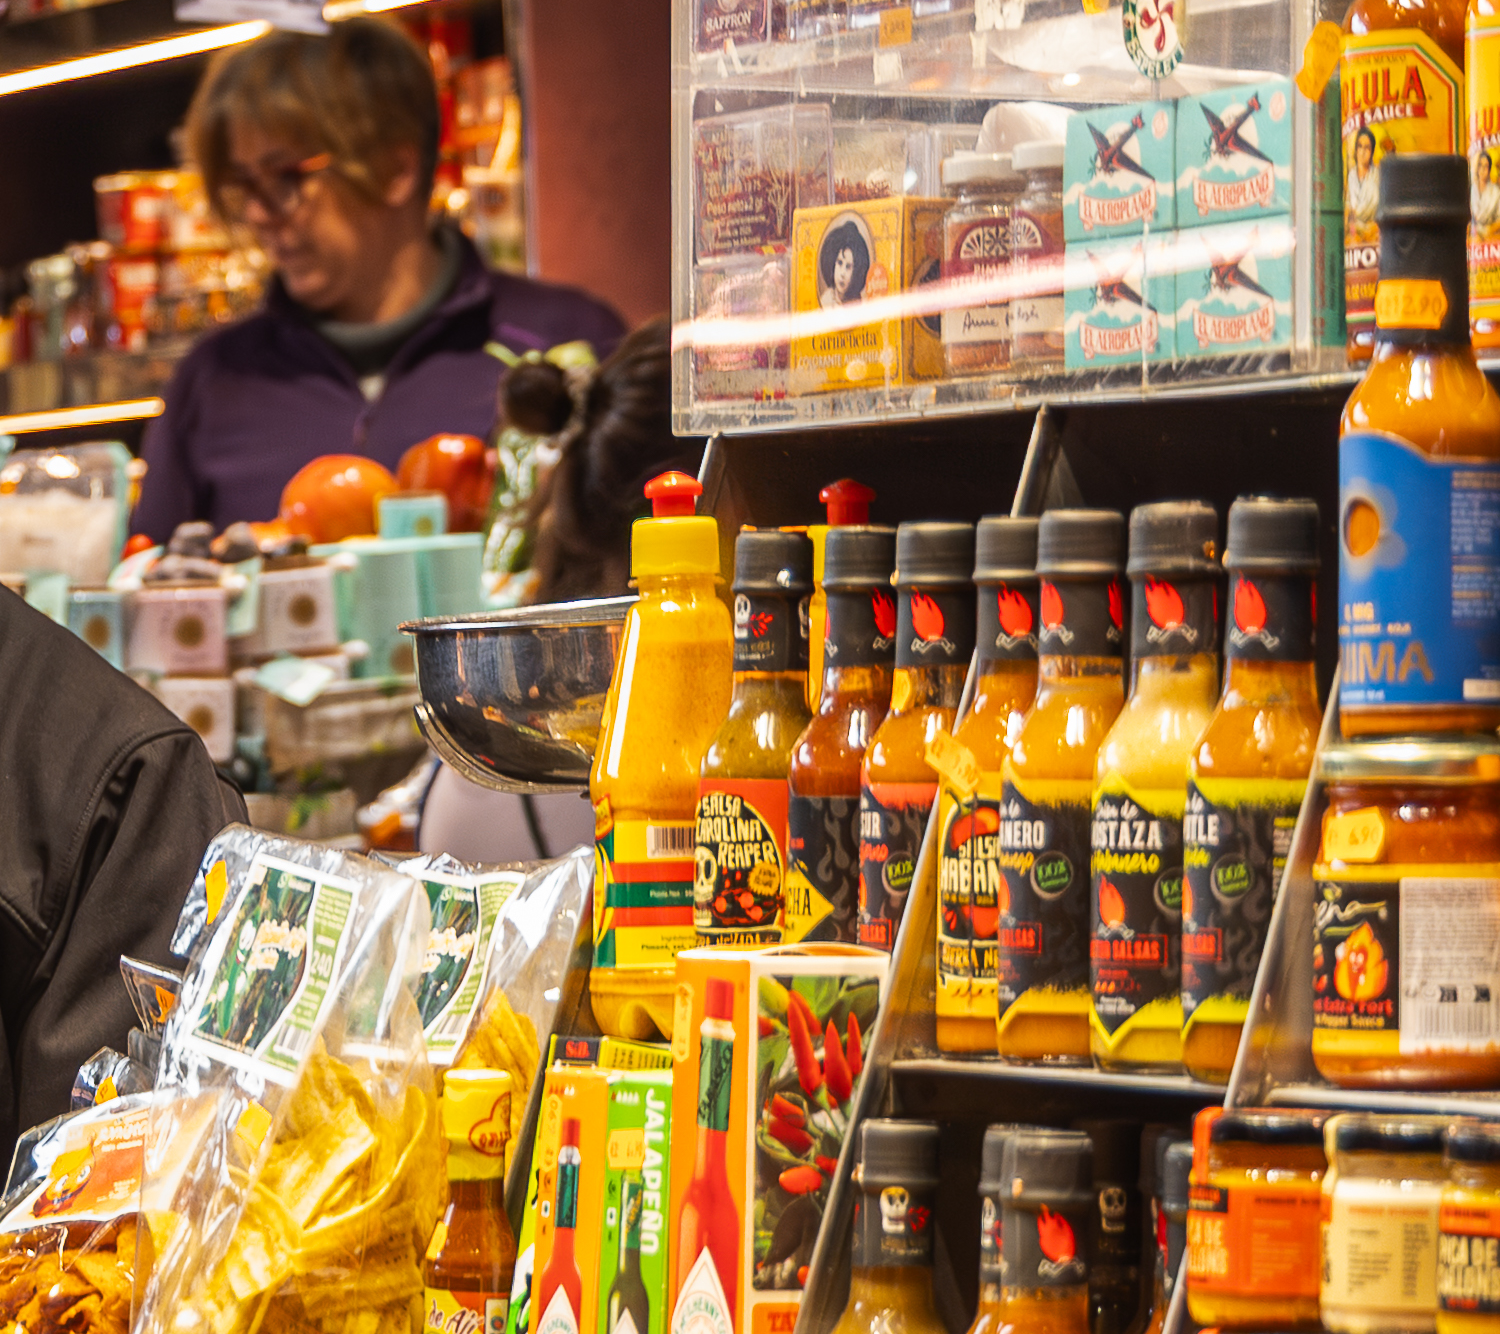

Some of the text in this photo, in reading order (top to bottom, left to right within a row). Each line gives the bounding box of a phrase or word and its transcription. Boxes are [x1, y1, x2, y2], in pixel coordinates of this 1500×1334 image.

[706, 10, 752, 33] SAFFRON
[1341, 66, 1427, 110] OLULA
[1364, 103, 1414, 125] SAUCE
[1095, 188, 1152, 221] AEROPLANO
[1209, 173, 1270, 207] AEROPLANO
[1209, 305, 1270, 340] AEROPLANO
[811, 330, 879, 353] Carmencita
[702, 795, 743, 820] SALSA
[697, 816, 762, 843] CAROLINA
[1001, 820, 1046, 849] NERO
[718, 840, 776, 865] REAPER
[941, 859, 999, 896] HABAN
[311, 951, 333, 977] 240
[644, 1088, 666, 1256] JALAPEÑO
[429, 1298, 444, 1328] de
